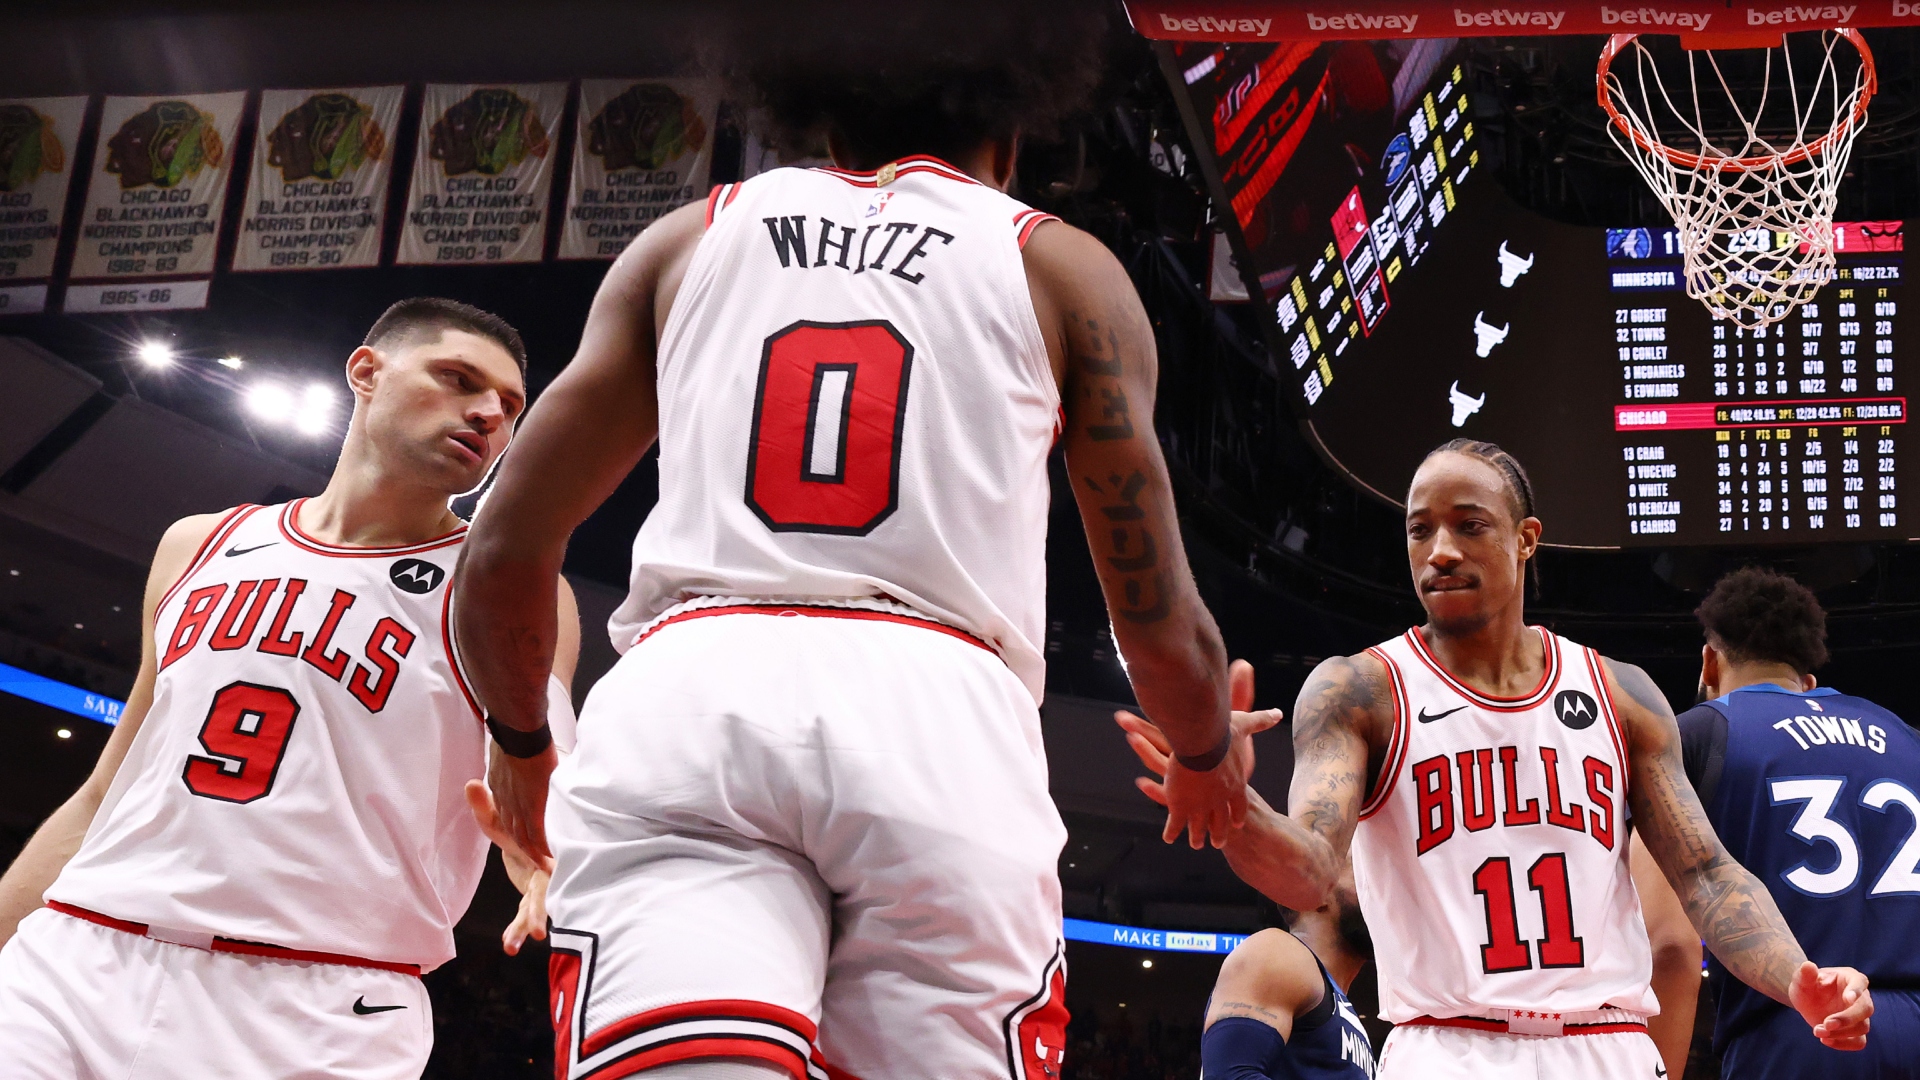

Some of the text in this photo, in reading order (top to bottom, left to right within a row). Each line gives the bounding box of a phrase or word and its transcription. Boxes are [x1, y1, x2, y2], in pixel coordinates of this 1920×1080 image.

[1307, 12, 1418, 33] betway
[1454, 8, 1565, 30] betway
[1601, 6, 1712, 31] betway
[1747, 3, 1857, 26] betway
[1160, 13, 1272, 36] betway
[445, 177, 517, 192] CHICAGO
[606, 171, 677, 186] CHICAGO
[120, 189, 191, 205] CHICAGO
[283, 182, 353, 198] CHICAGO
[583, 186, 694, 203] BLACKHAWKS
[259, 196, 371, 215] BLACKHAWKS
[422, 192, 533, 209] BLACKHAWKS
[96, 204, 209, 221] BLACKHAWKS
[410, 209, 541, 227] NORRIS DIVISION
[571, 206, 630, 220] NORRIS
[84, 221, 215, 239] NORRIS DIVISION
[245, 213, 377, 233] NORRIS DIVISION
[587, 224, 645, 238] CHAMP
[260, 233, 355, 249] CHAMPIONS
[423, 228, 520, 244] CHAMPIONS
[99, 239, 193, 256] CHAMPIONS
[763, 215, 955, 285] WHITE
[1613, 272, 1675, 287] MINNESOTA
[100, 289, 171, 305] 1985-86
[1840, 288, 1888, 298] 3PT FT
[1616, 310, 1628, 323] 27
[1616, 328, 1629, 342] 32
[1631, 327, 1665, 341] TOWNS
[1714, 326, 1724, 339] 31
[1776, 324, 1783, 337] 4
[1619, 347, 1630, 360] 10
[1737, 344, 1742, 357] 1
[1624, 366, 1631, 379] 3
[1714, 363, 1726, 377] 32
[1737, 363, 1744, 376] 2
[1755, 362, 1766, 375] 13
[1778, 362, 1784, 375] 2
[1625, 385, 1632, 398] 5
[1715, 382, 1727, 395] 36
[1738, 382, 1745, 394] 3
[1755, 381, 1768, 394] 32
[1619, 411, 1667, 425] CHICAGO
[744, 319, 915, 537] 0
[1741, 430, 1746, 440] F
[1756, 430, 1771, 440] PTS
[1776, 429, 1791, 439] REB
[1808, 428, 1818, 437] FG
[1843, 427, 1857, 436] 3PT
[1881, 426, 1890, 435] FT
[1623, 447, 1634, 460] 13
[1637, 446, 1664, 460] CRAIG
[1718, 444, 1729, 458] 19
[1760, 443, 1766, 456] 7
[1780, 443, 1787, 456] 5
[1806, 442, 1821, 455] 2/5
[1844, 440, 1858, 454] 1/4
[1878, 439, 1894, 453] 2/2
[1628, 466, 1635, 479] 9
[1637, 465, 1676, 478] VUCEVIC
[1718, 463, 1730, 476] 35
[1741, 463, 1747, 475] 4
[1758, 462, 1770, 475] 24
[1781, 461, 1787, 474] 5
[1843, 459, 1858, 473] 2/3
[1879, 458, 1894, 472] 2/2
[1638, 483, 1668, 497] WHITE
[1719, 482, 1731, 494] 34
[1741, 481, 1748, 494] 4
[1782, 480, 1788, 493] 5
[1879, 476, 1895, 490] 3/4
[1627, 503, 1637, 515] 11
[1719, 500, 1731, 513] 35
[1742, 499, 1749, 512] 2
[1782, 498, 1788, 511] 3
[1631, 521, 1638, 534] 6
[1720, 518, 1731, 531] 27
[1744, 518, 1748, 530] 1
[1763, 517, 1769, 530] 3
[158, 577, 416, 714] BULLS
[181, 680, 302, 804] 9
[1773, 715, 1887, 754] TOWNS
[1412, 746, 1615, 857] BULLS
[1766, 775, 1920, 899] 32
[1473, 853, 1585, 975] 11
[1113, 928, 1161, 948] MAKE
[1171, 934, 1212, 950] today
